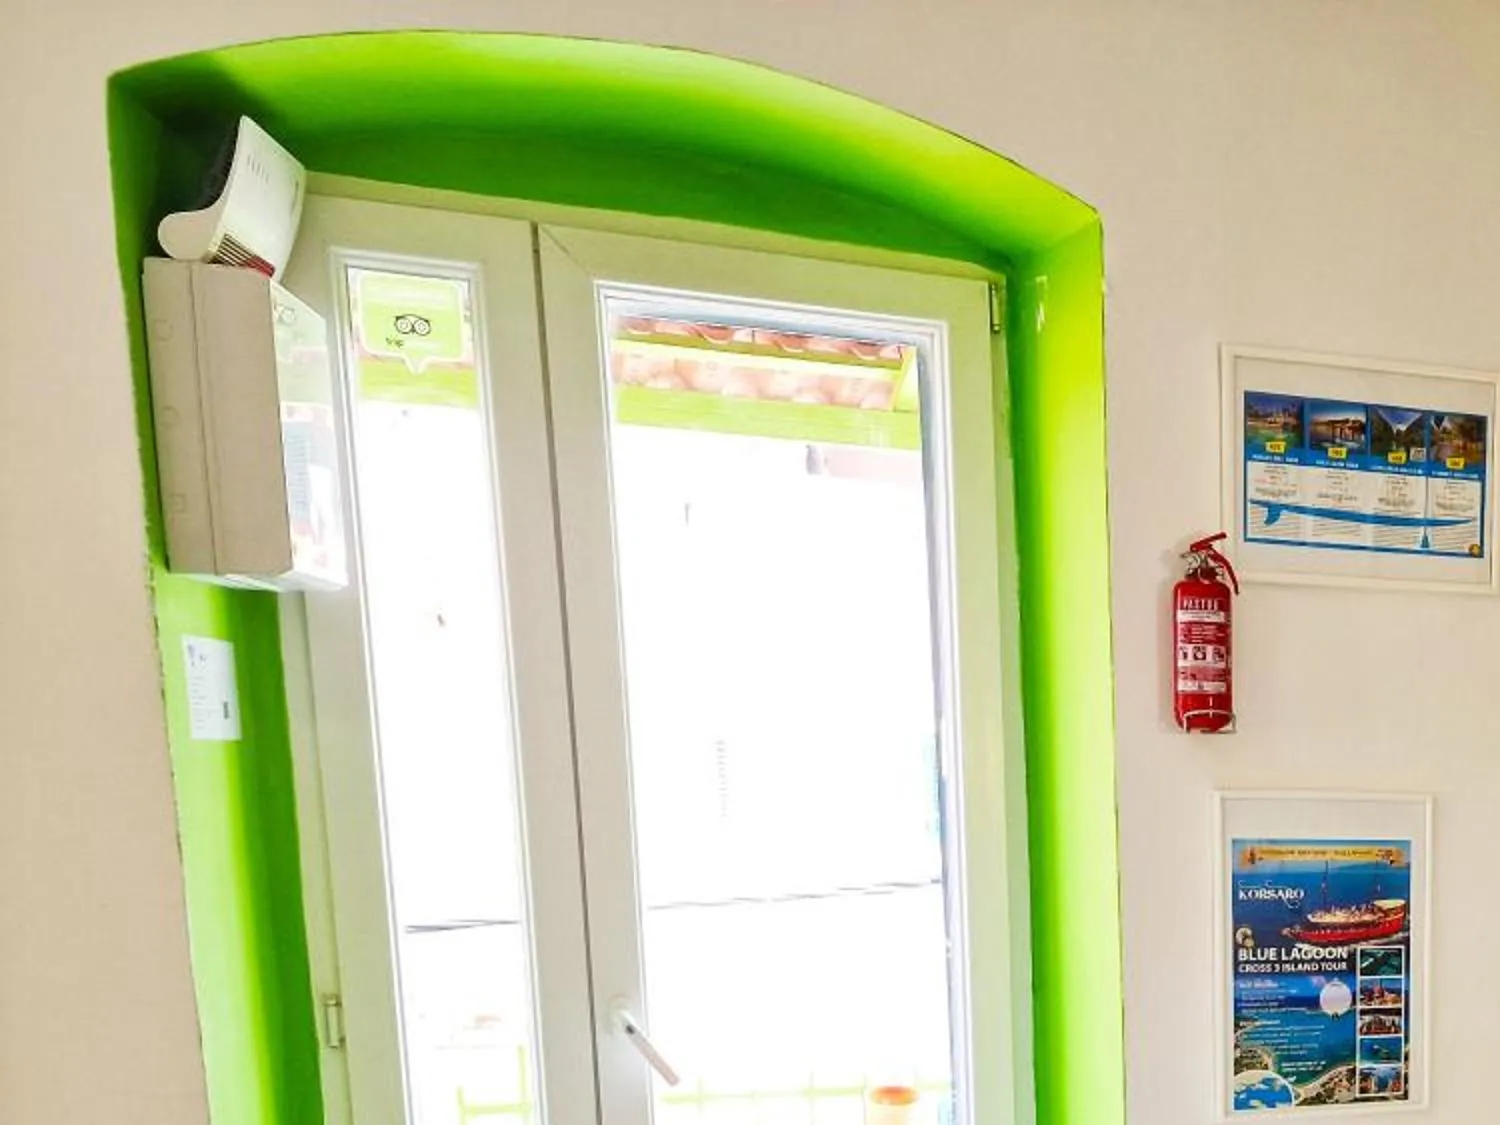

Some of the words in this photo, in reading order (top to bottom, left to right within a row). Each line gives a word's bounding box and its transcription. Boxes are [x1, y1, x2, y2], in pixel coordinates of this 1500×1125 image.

[1239, 947, 1278, 961] BLUE
[1281, 947, 1349, 961] LAGOON
[1239, 963, 1272, 973] CROSS
[1274, 963, 1280, 973] 3
[1282, 963, 1319, 973] ISLAND
[1321, 962, 1348, 972] TOUR
